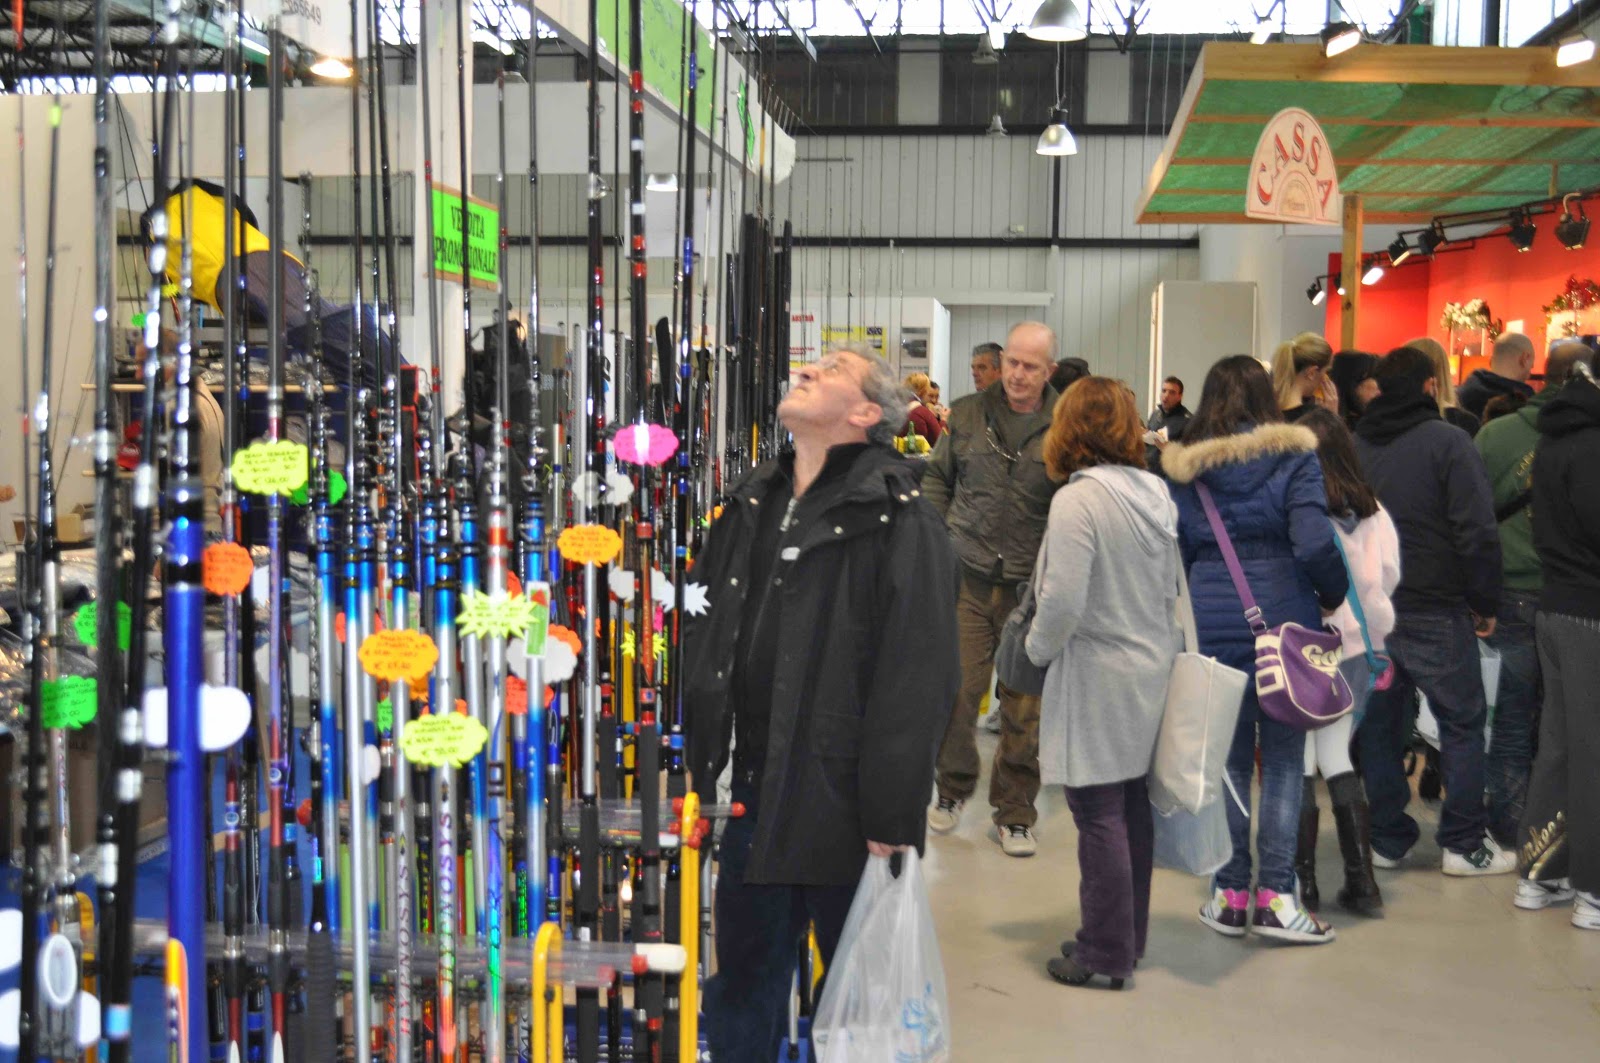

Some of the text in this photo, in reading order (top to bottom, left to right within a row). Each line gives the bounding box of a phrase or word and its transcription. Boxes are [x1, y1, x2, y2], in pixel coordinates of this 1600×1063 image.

[1257, 121, 1333, 217] CASSA
[451, 206, 485, 240] VEDITA
[399, 863, 412, 1037] HYPNOSYS
